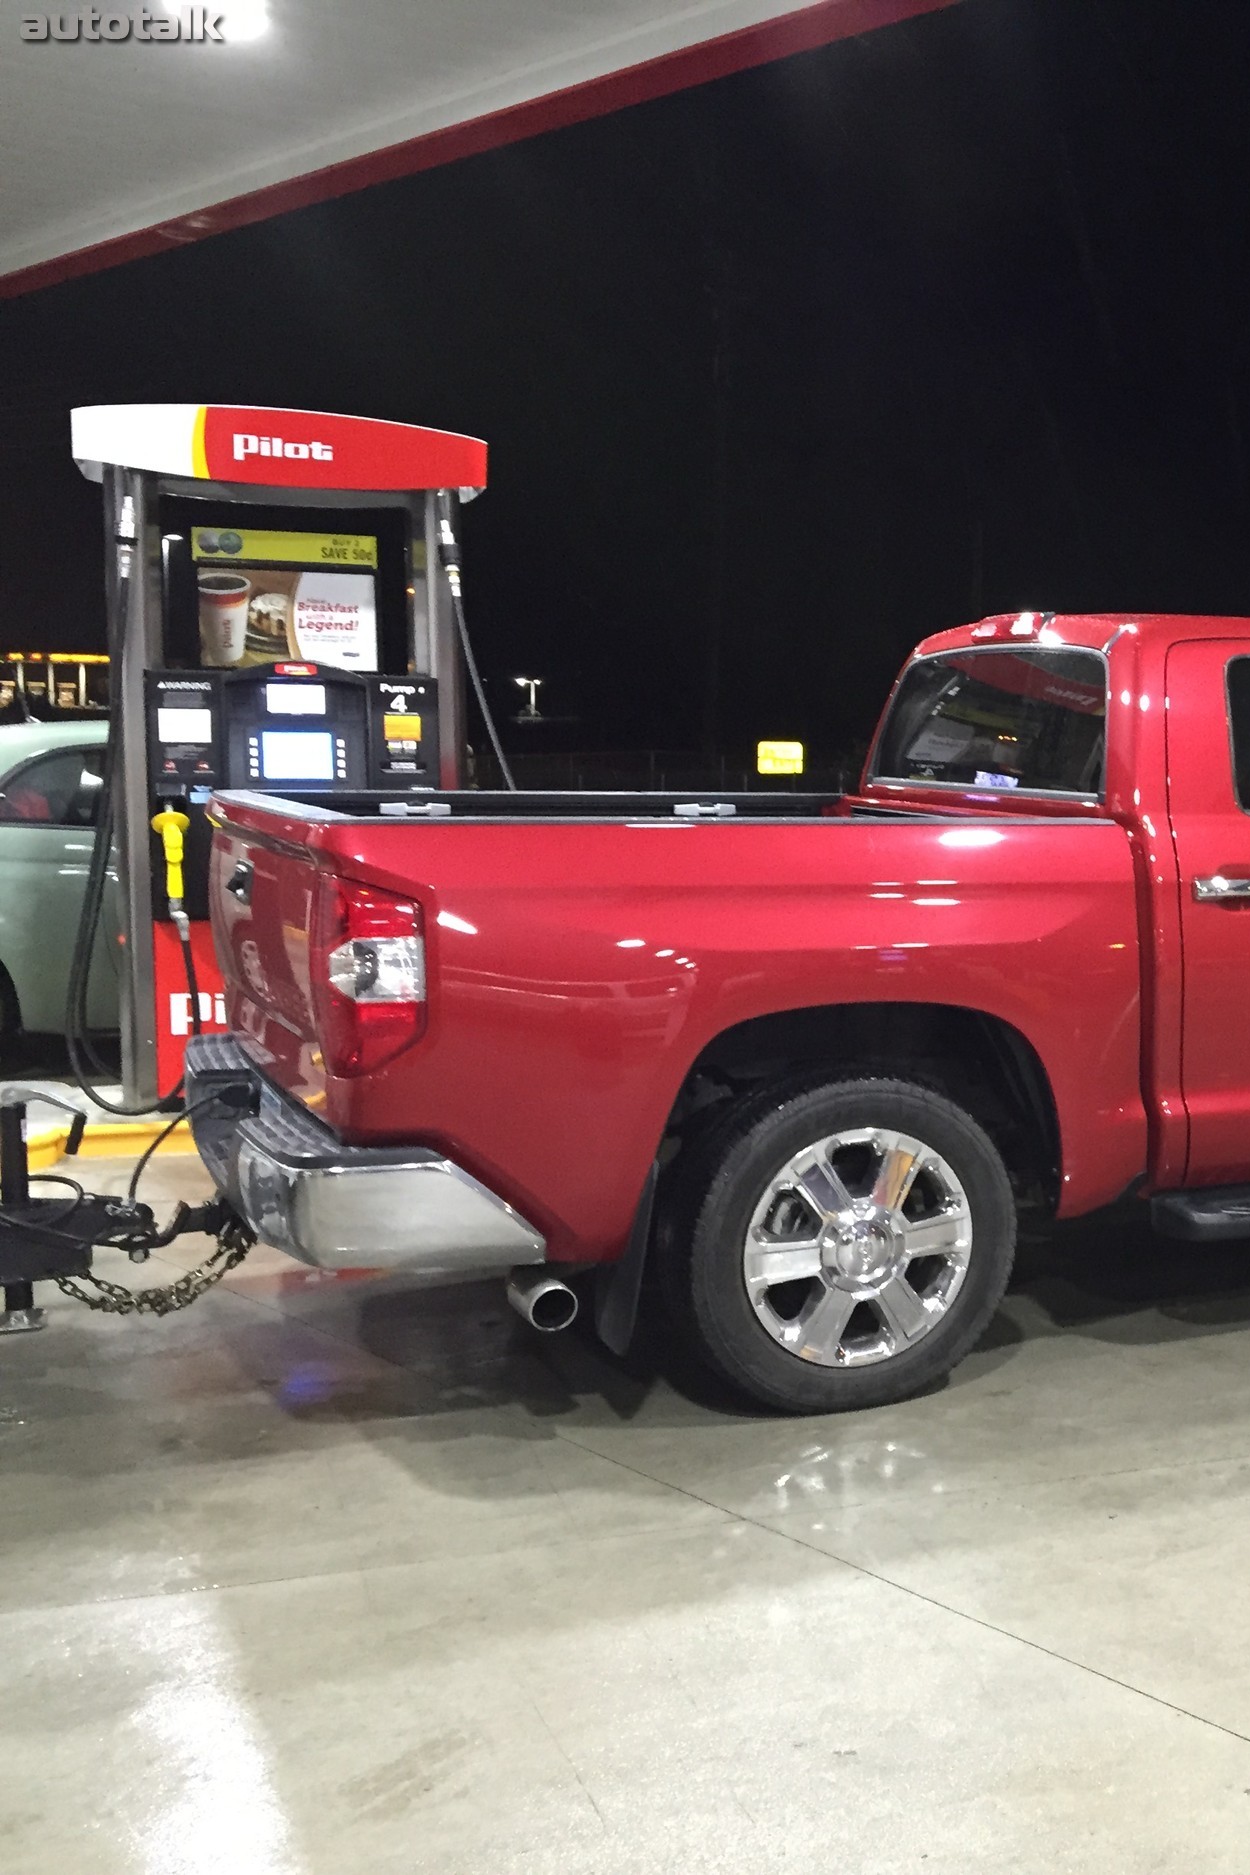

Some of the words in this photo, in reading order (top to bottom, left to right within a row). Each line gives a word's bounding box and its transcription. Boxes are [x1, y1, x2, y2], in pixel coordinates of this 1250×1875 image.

[232, 433, 333, 461] Pilot
[320, 546, 348, 560] SAVE
[297, 601, 359, 614] Breakfast
[298, 618, 359, 633] Legend!
[165, 681, 212, 691] WARNING
[379, 682, 416, 695] Pump
[389, 693, 408, 713] 4
